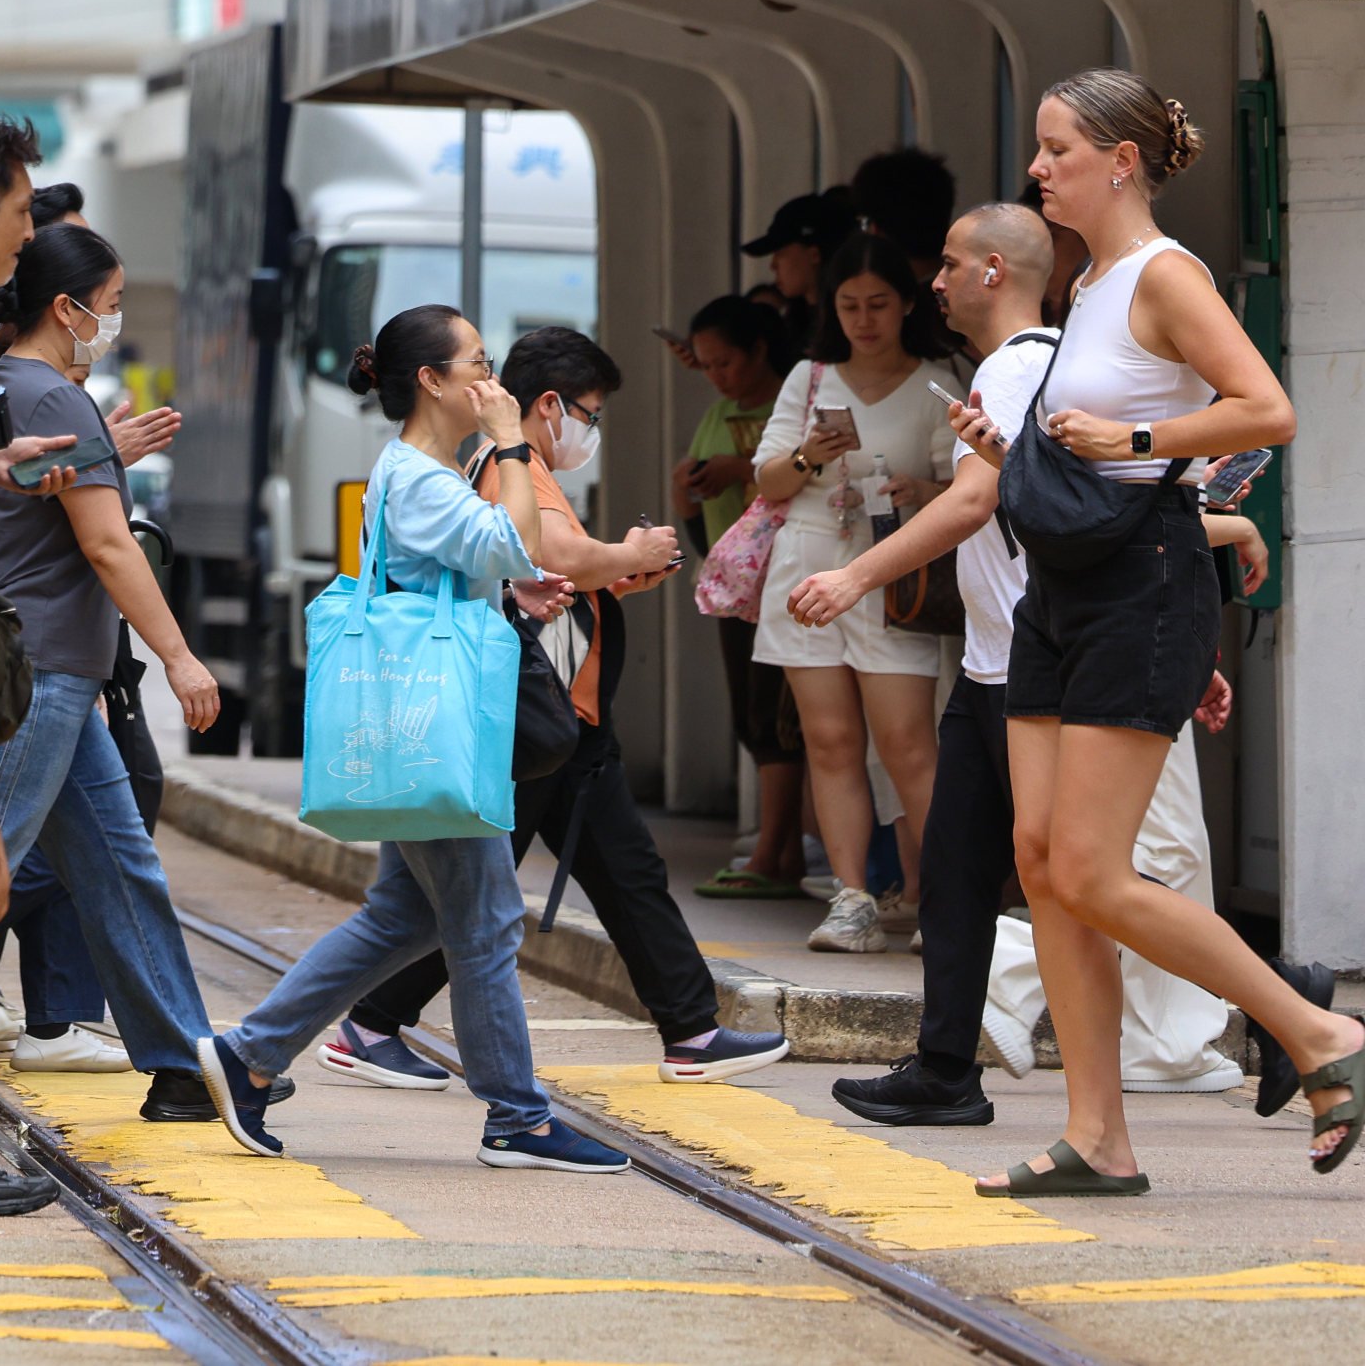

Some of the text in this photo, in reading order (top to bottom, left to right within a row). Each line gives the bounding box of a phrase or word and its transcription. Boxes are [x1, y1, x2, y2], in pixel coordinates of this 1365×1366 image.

[377, 648, 412, 663] For a
[339, 667, 448, 688] Better Hong Kong
